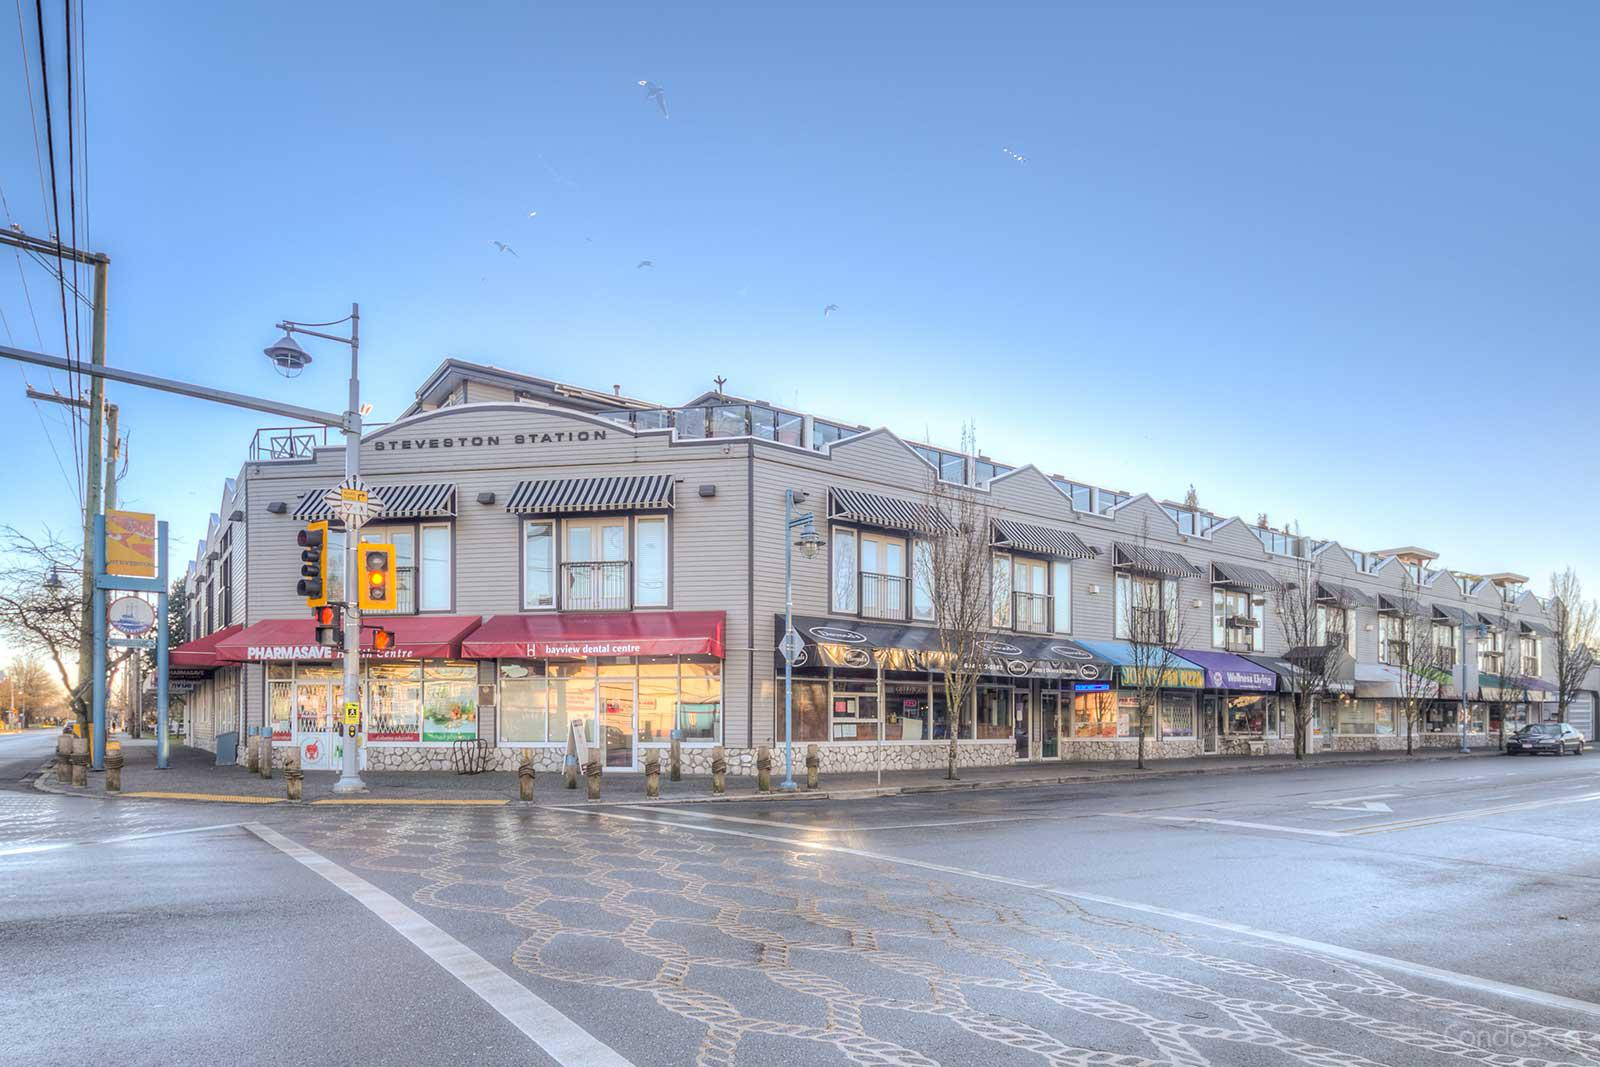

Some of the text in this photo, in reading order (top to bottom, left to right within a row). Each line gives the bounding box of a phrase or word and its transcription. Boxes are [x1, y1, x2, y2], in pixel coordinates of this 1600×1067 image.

[374, 430, 608, 451] STEVESTON STATION
[247, 646, 333, 660] PHARMASAVE
[545, 643, 641, 656] bayview dental centre
[1226, 671, 1253, 684] Wellness
